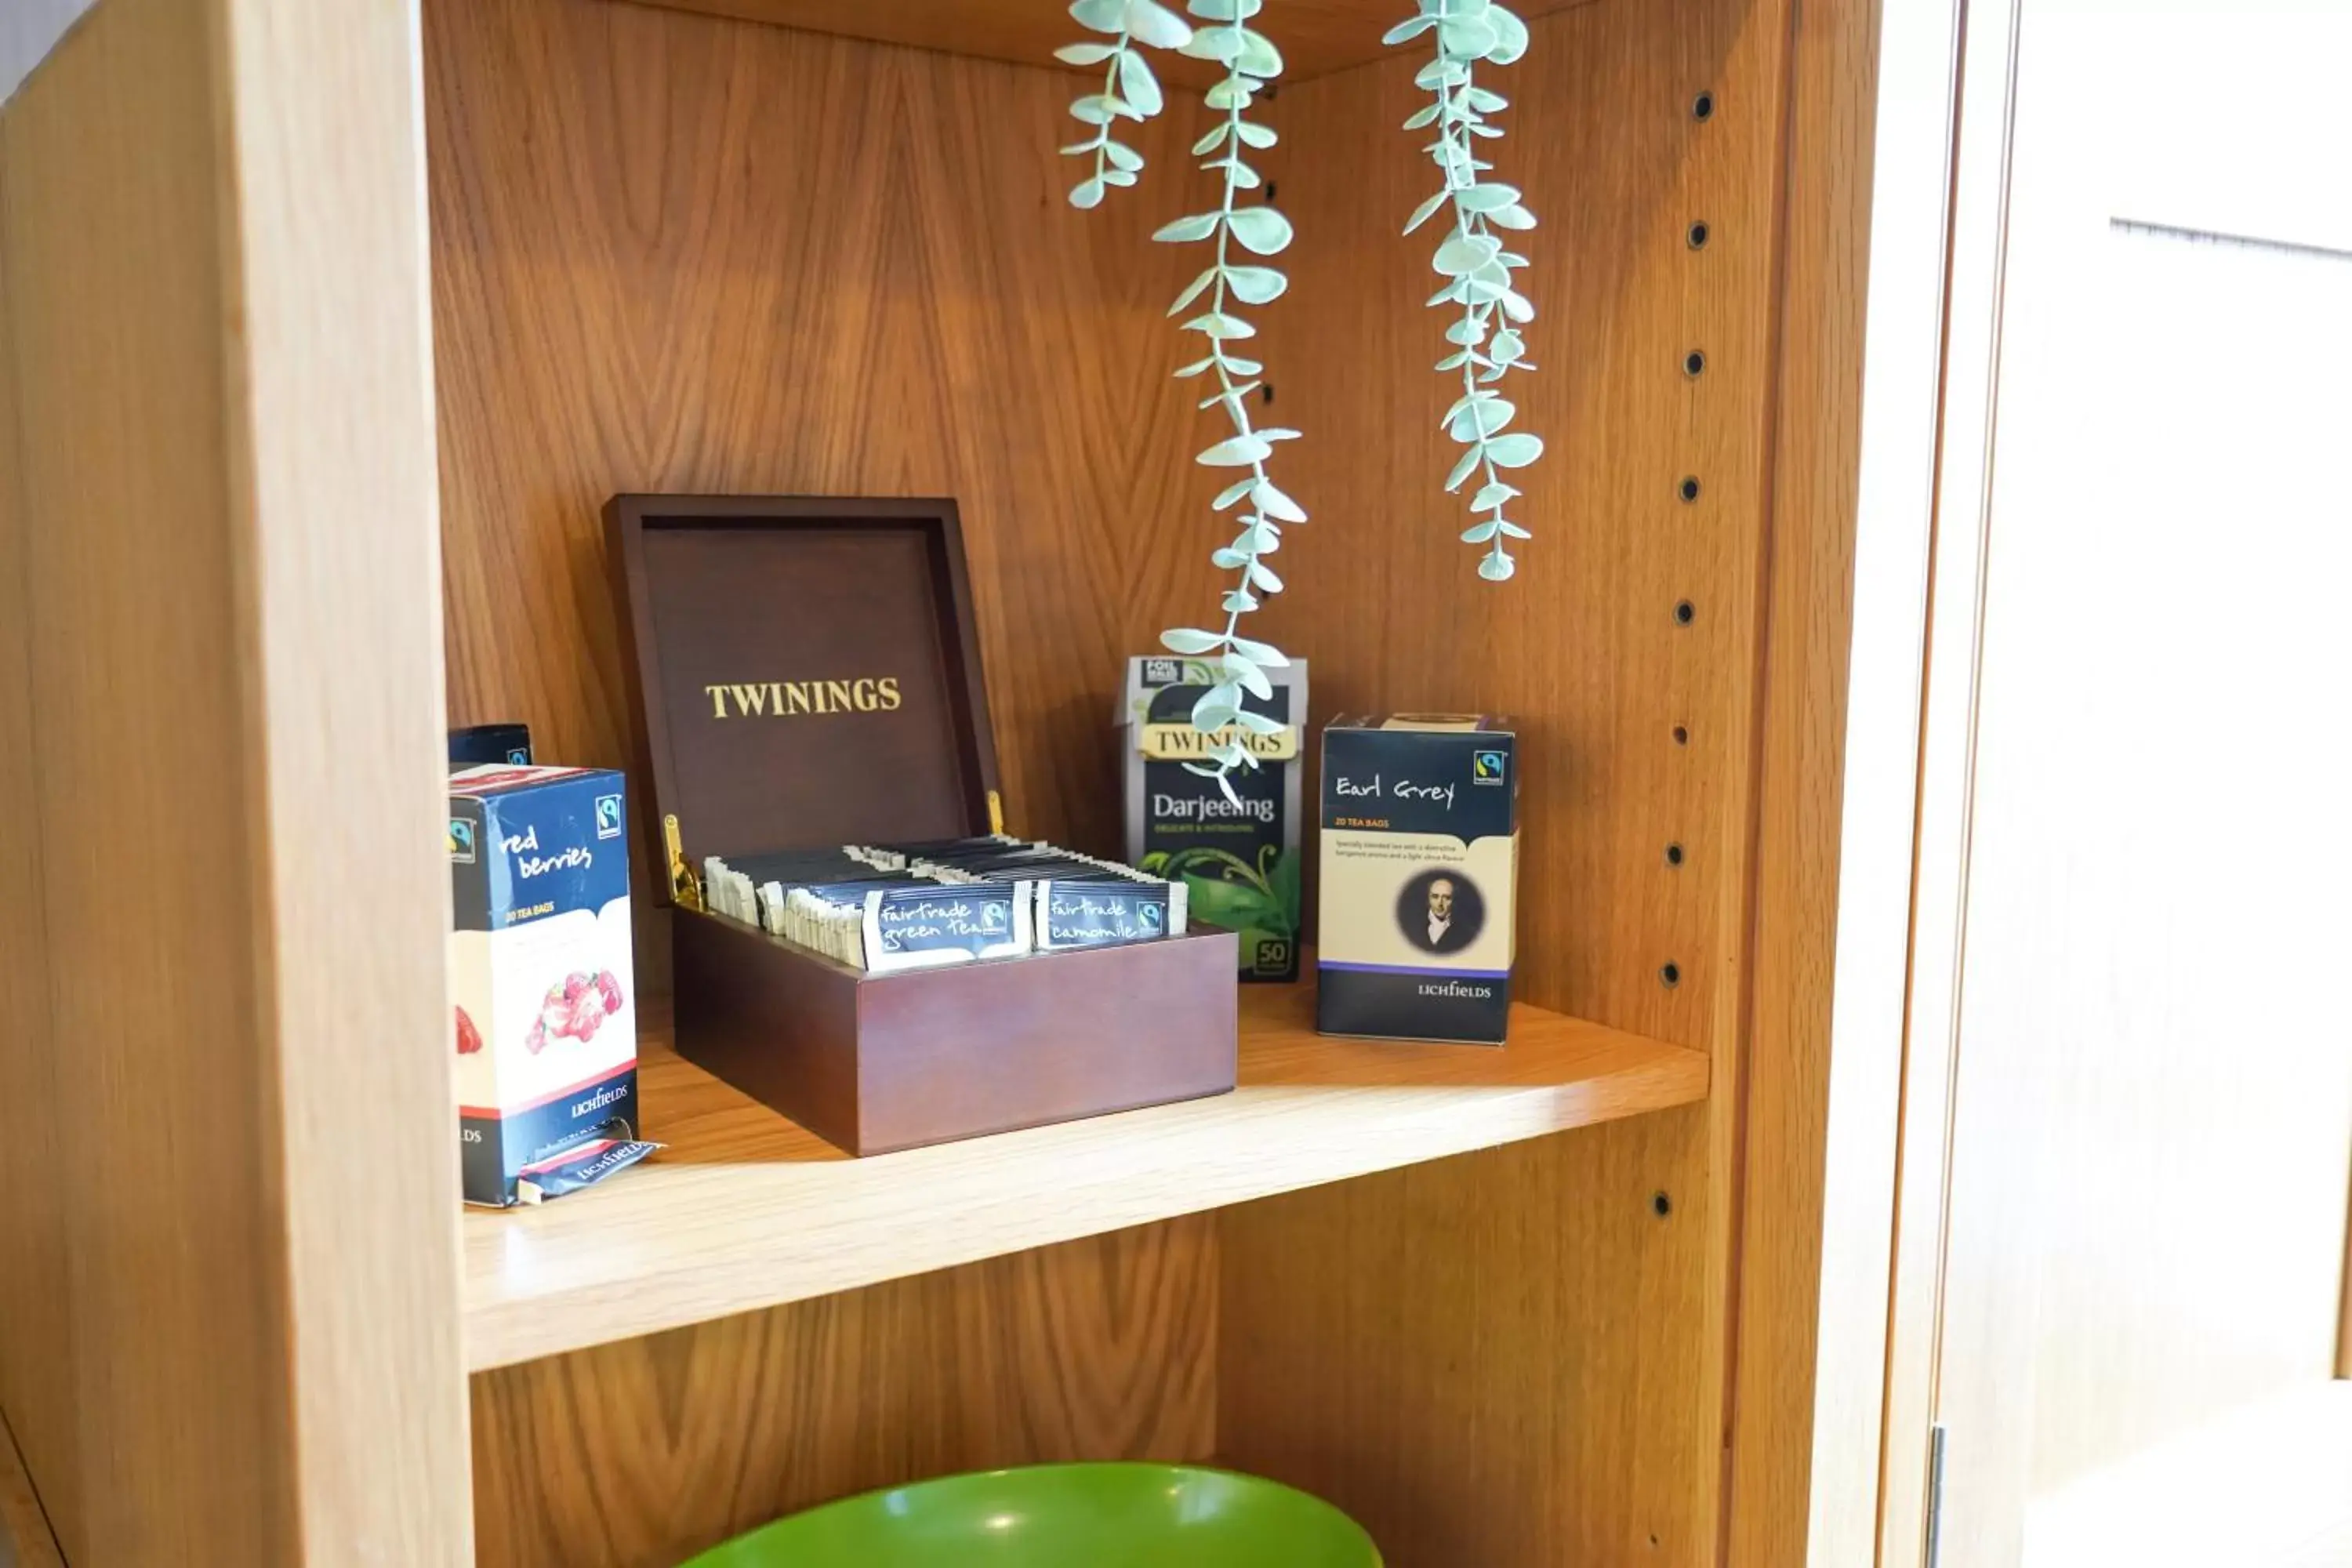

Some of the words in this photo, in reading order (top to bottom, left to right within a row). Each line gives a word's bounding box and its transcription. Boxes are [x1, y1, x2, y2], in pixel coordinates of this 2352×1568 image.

[705, 677, 902, 718] TWININGS
[1336, 773, 1381, 797] Earl
[1393, 780, 1455, 810] Grey
[1348, 818, 1364, 828] TEA
[1365, 818, 1391, 829] BAGS
[498, 824, 539, 854] red
[517, 847, 593, 879] berries
[884, 924, 942, 950] green
[1052, 919, 1138, 938] camomile
[1260, 942, 1286, 963] 50
